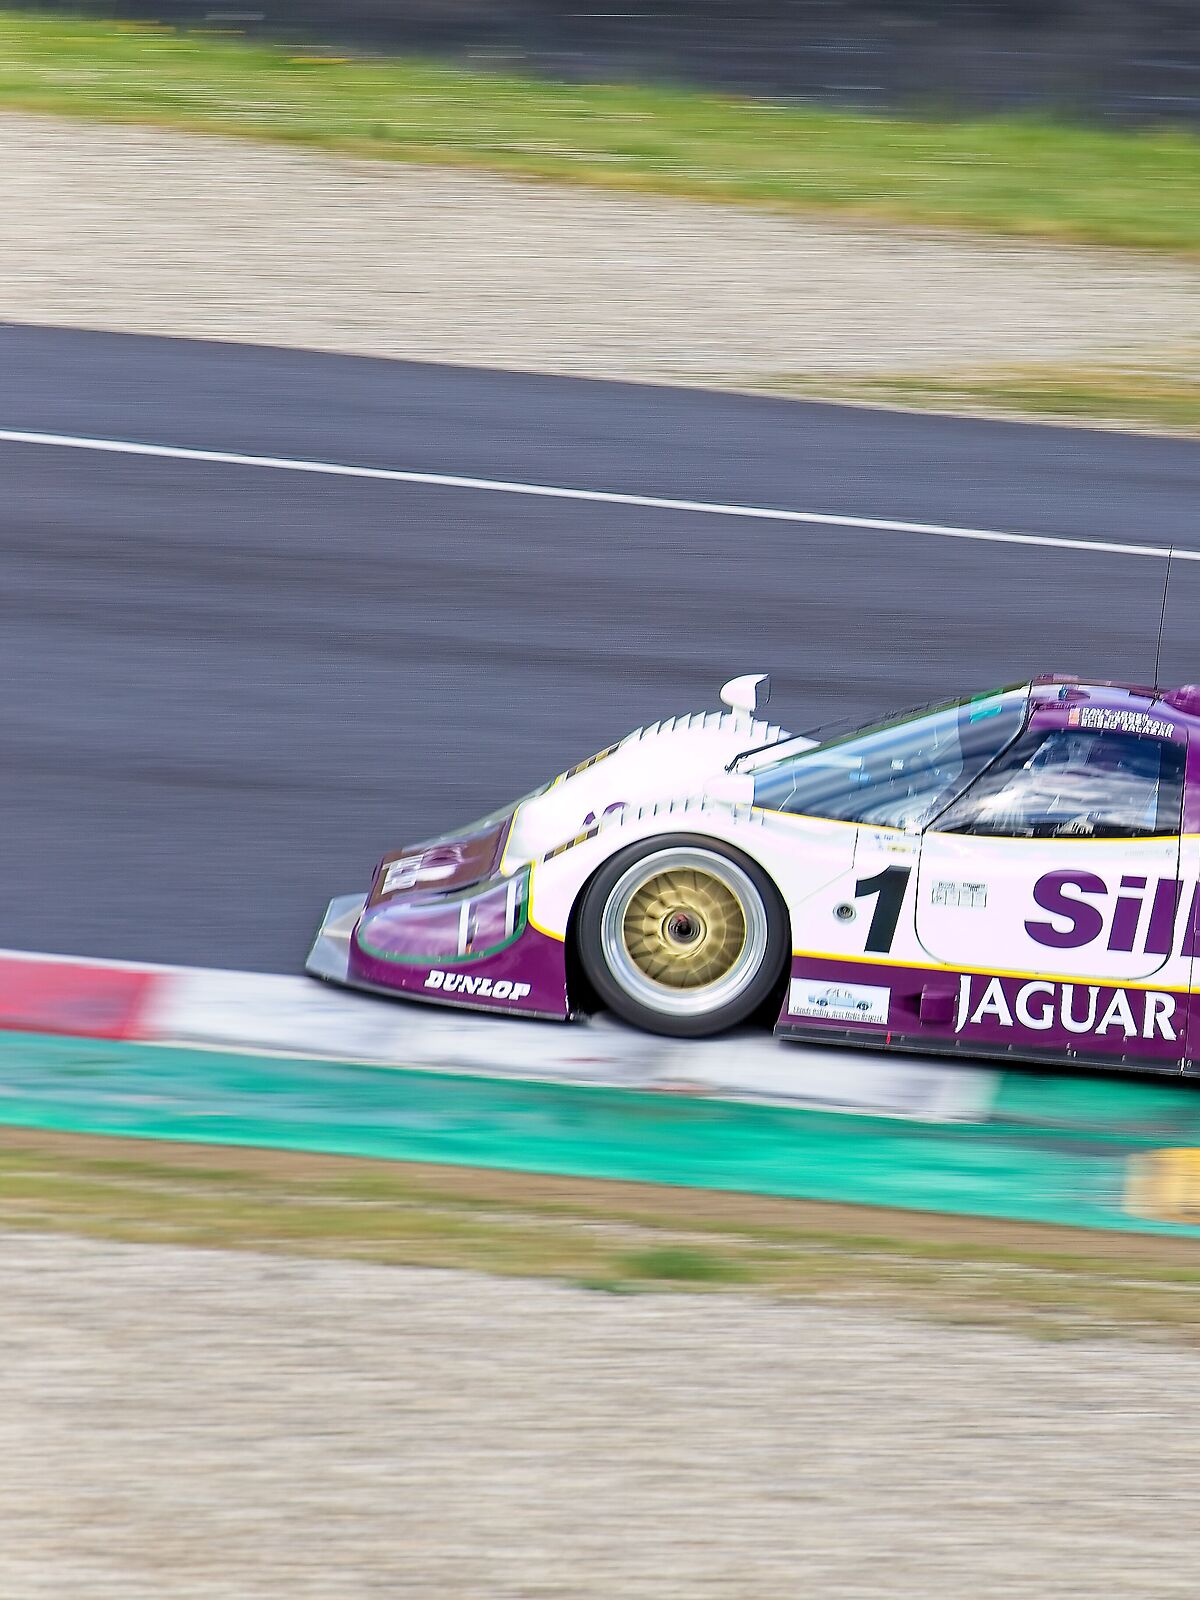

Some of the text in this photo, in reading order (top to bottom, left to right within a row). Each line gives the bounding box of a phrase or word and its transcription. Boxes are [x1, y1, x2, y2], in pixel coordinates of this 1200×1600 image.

[854, 864, 912, 954] 1
[424, 969, 531, 1001] DUNLOP
[954, 974, 1178, 1041] JAGUAR
